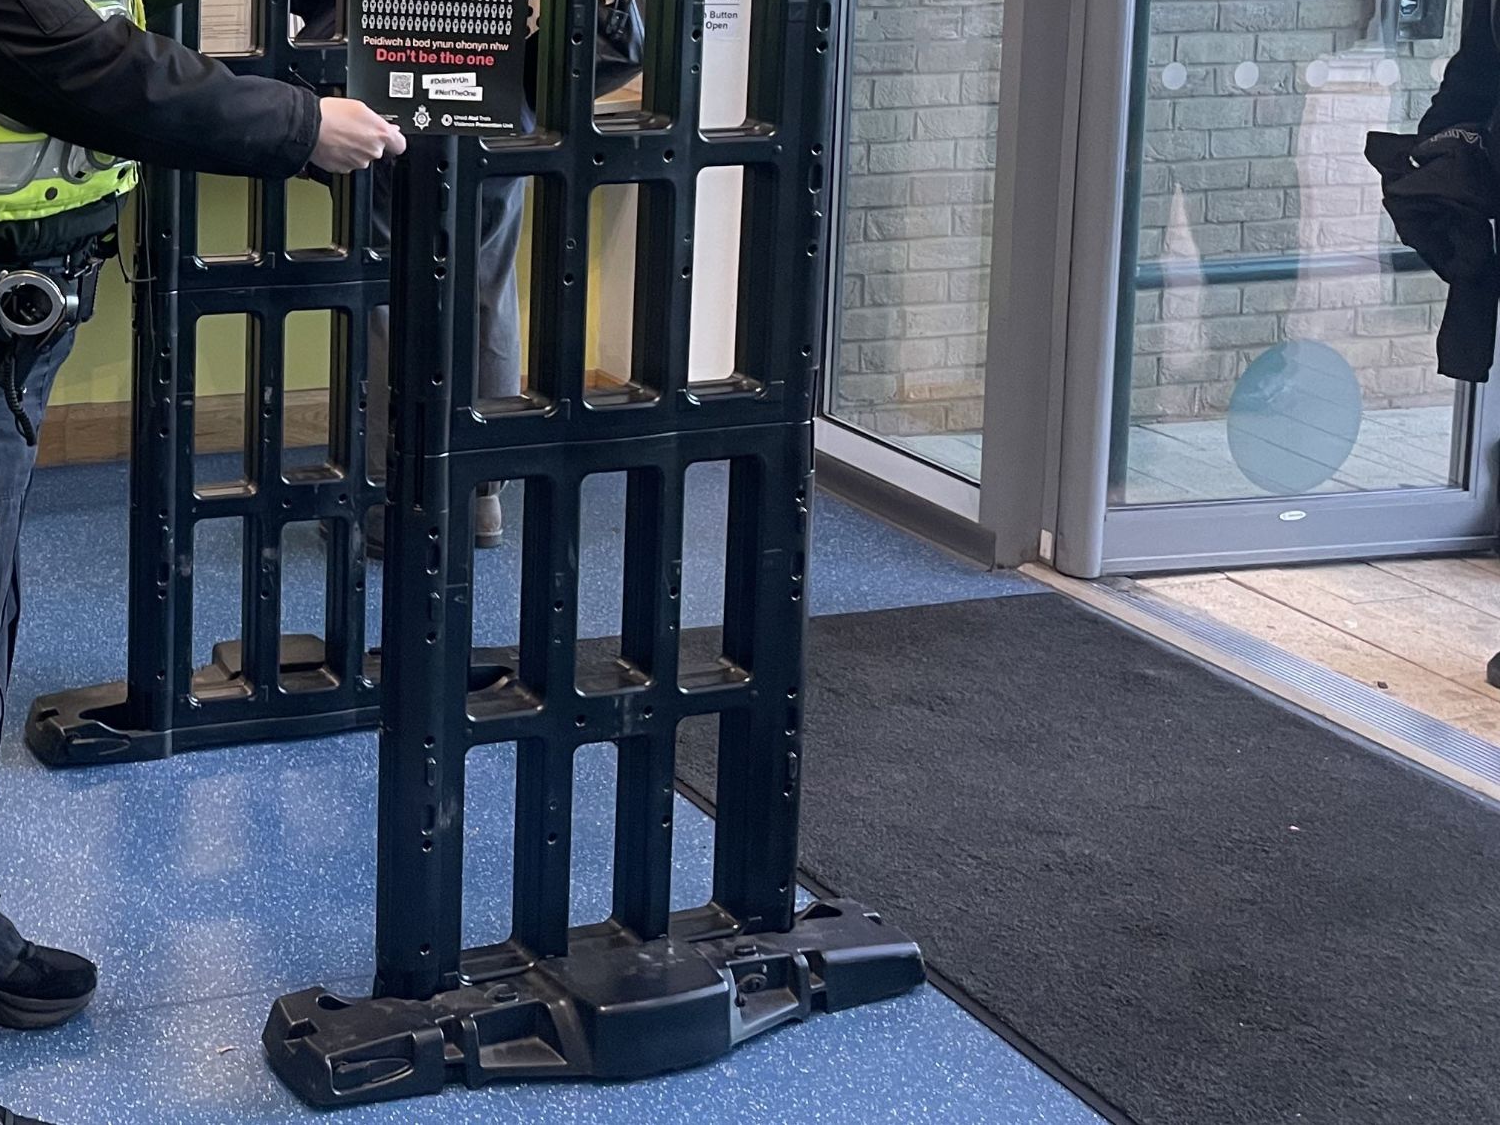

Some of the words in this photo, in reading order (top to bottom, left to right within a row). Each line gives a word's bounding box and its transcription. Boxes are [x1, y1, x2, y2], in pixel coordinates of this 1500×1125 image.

[710, 10, 738, 18] Button
[706, 21, 728, 31] Open
[364, 36, 404, 46] Peidiwch
[412, 38, 430, 48] bod
[456, 40, 488, 52] ohonyn
[490, 42, 509, 50] nhw
[376, 48, 416, 62] Don't
[419, 50, 438, 64] be
[440, 51, 464, 64] the
[467, 54, 494, 66] one
